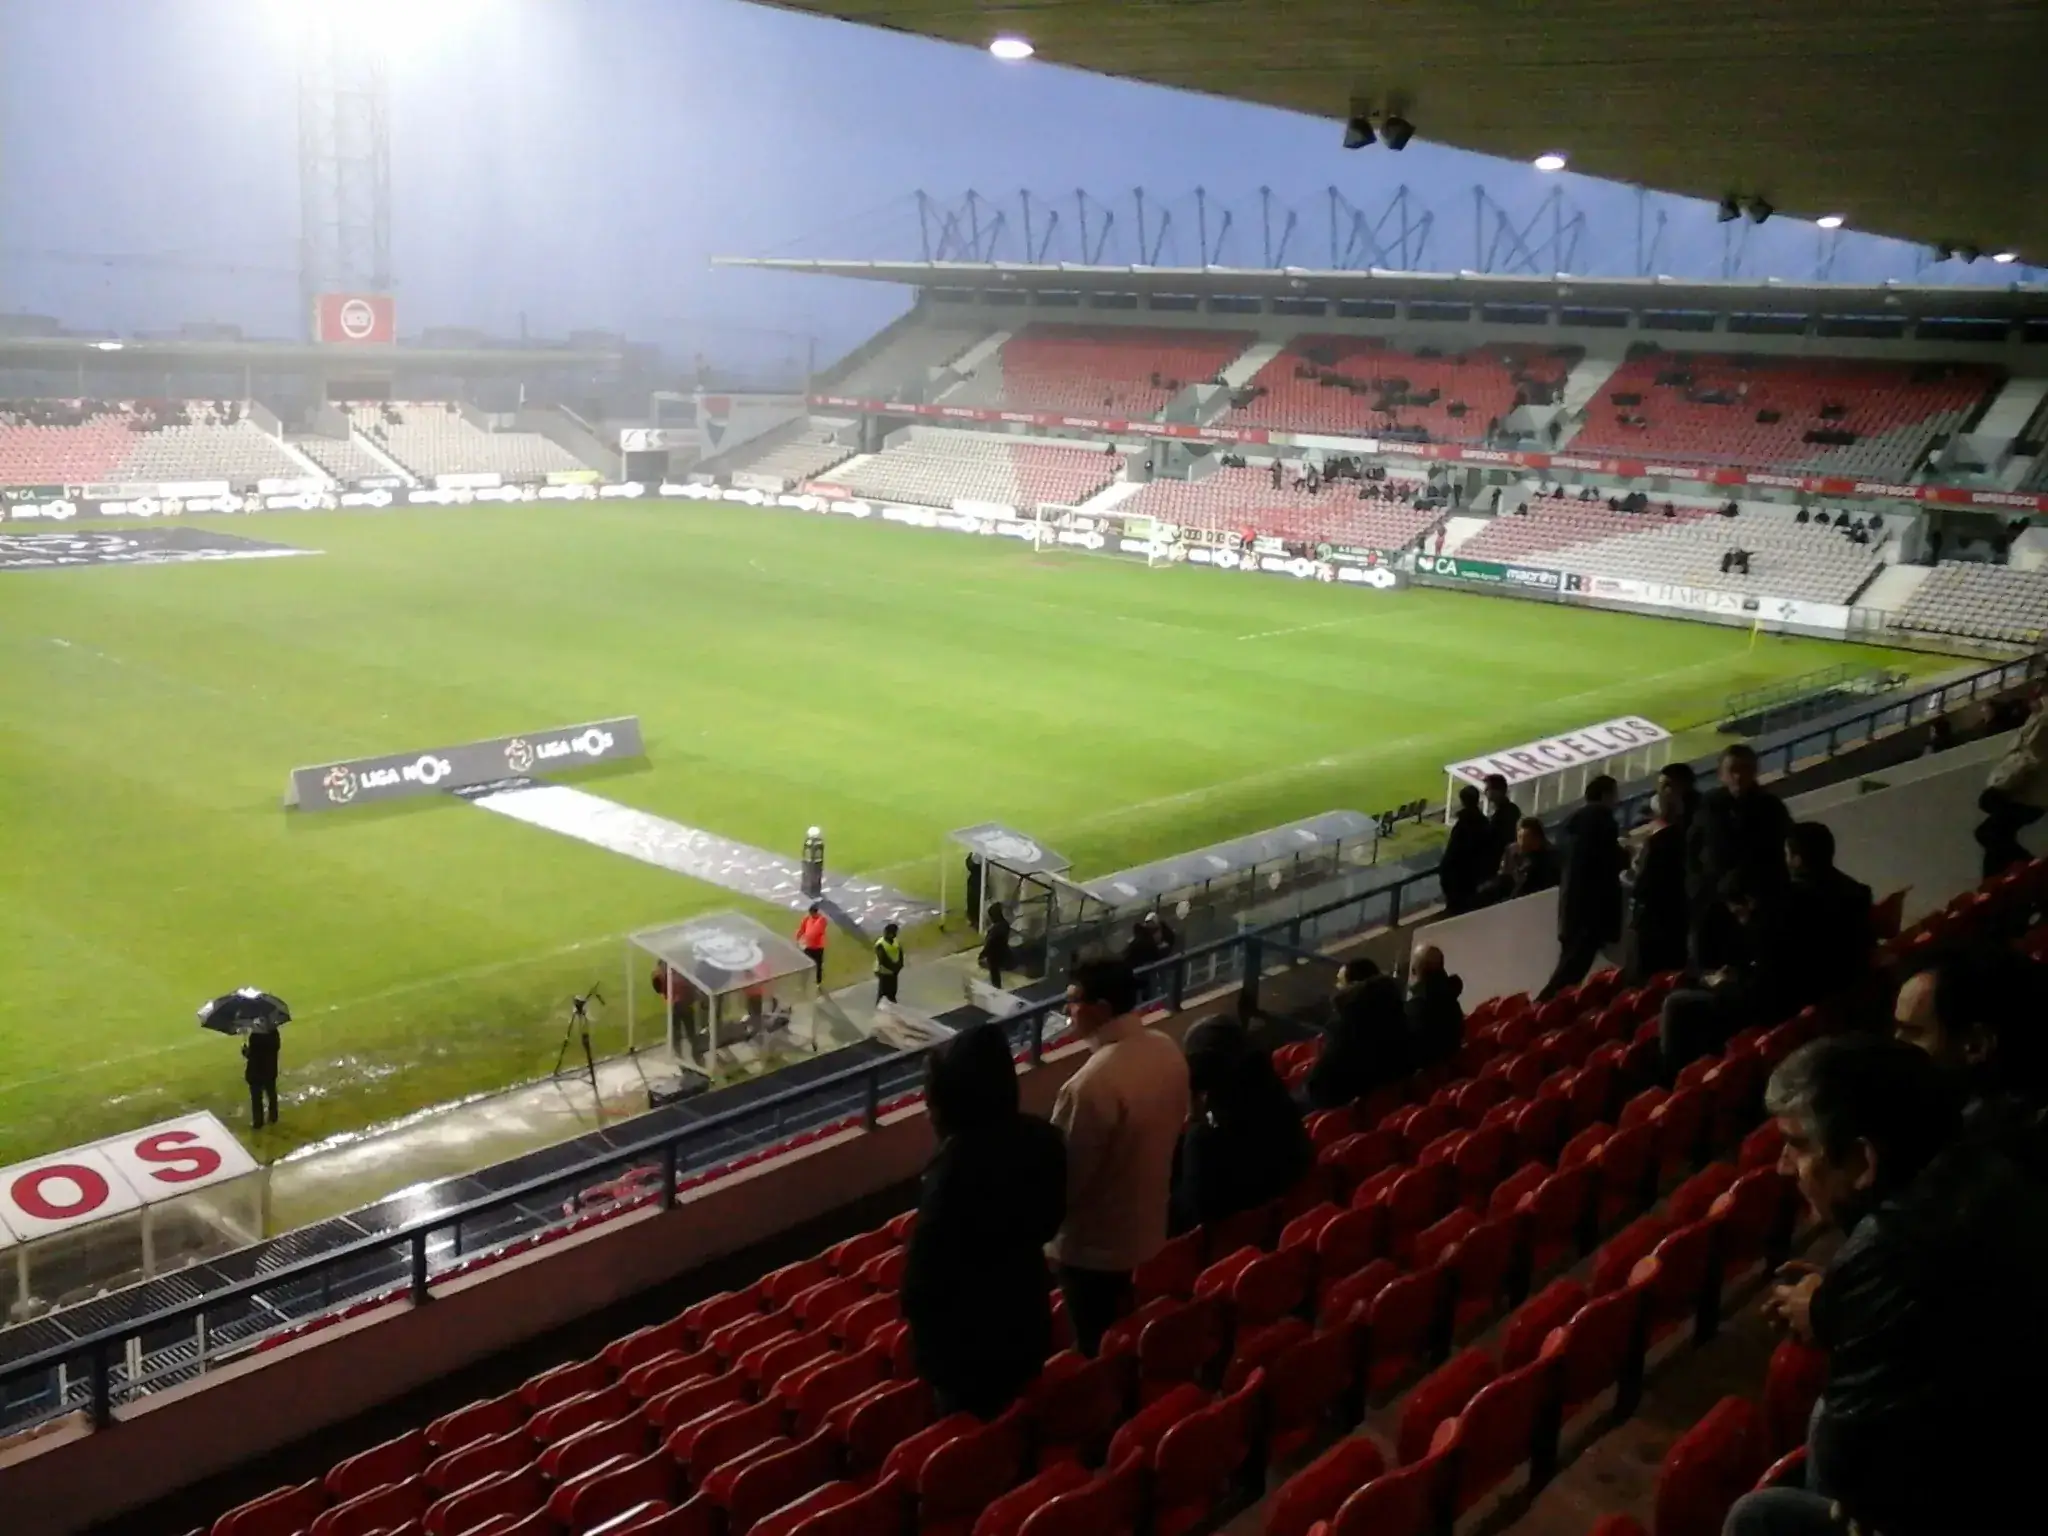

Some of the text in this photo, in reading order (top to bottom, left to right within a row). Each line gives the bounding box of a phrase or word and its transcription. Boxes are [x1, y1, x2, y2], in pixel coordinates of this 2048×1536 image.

[1435, 559, 1457, 576] CA
[535, 739, 571, 760] LIGA
[1457, 720, 1660, 782] BARCELOS
[360, 765, 401, 790] LIGA
